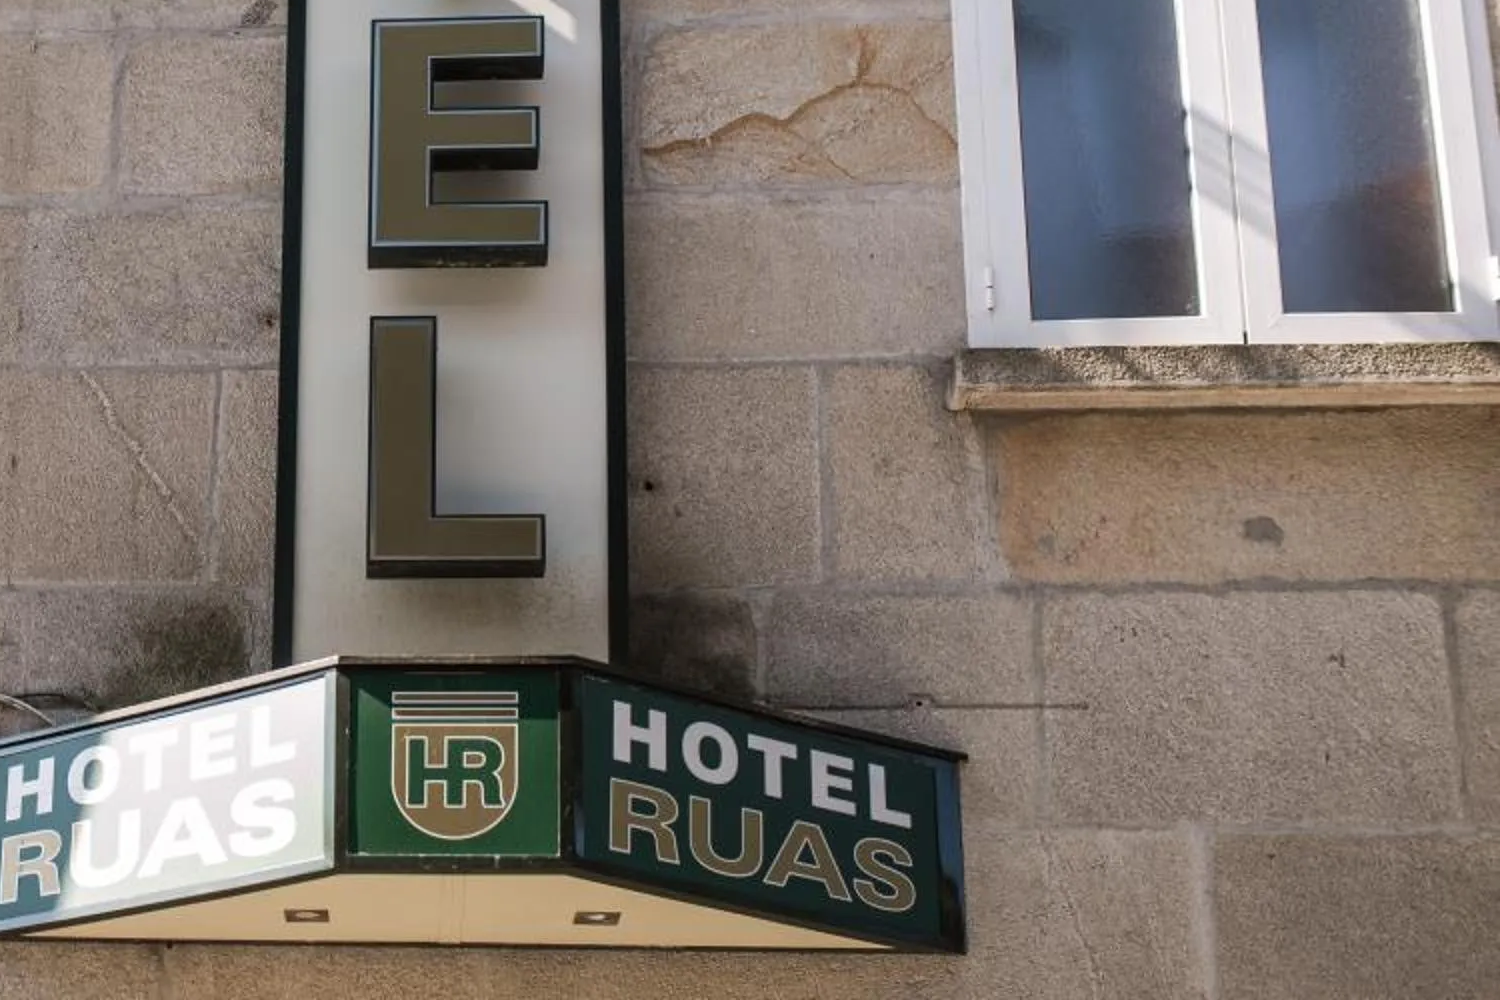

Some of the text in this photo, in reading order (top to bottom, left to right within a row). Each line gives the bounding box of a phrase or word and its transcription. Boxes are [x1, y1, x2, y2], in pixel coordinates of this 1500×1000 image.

[5, 710, 296, 822] HOTEL
[406, 733, 509, 810] HR
[611, 699, 913, 829] HOTEL
[608, 777, 916, 913] RUAS
